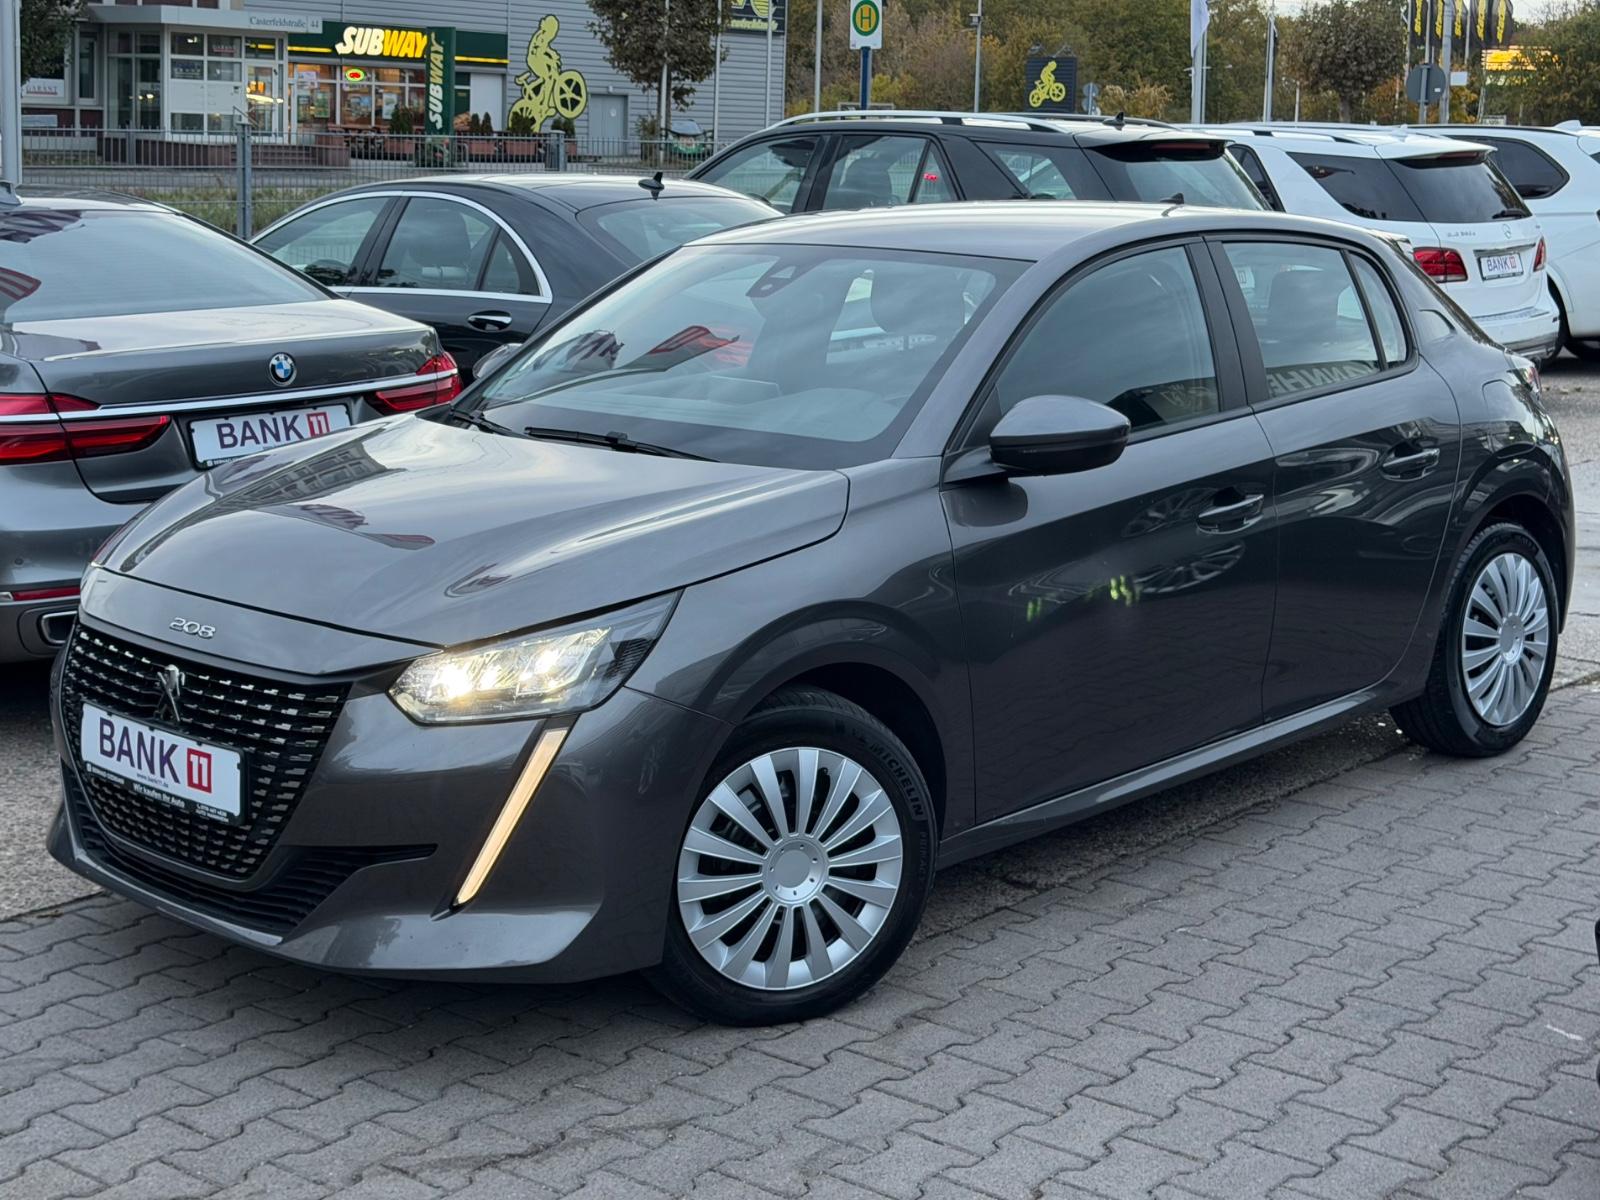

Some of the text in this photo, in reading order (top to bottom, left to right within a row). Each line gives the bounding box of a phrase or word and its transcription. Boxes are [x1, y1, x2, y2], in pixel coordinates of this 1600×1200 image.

[861, 7, 871, 28] H
[334, 26, 428, 58] SUBWAY
[428, 32, 444, 130] SUBWAY
[1487, 256, 1511, 272] BANK
[216, 413, 329, 450] BANK 11
[169, 617, 216, 638] 208
[99, 717, 181, 784] BANK
[188, 750, 211, 791] 11
[869, 742, 924, 817] MICHELIN
